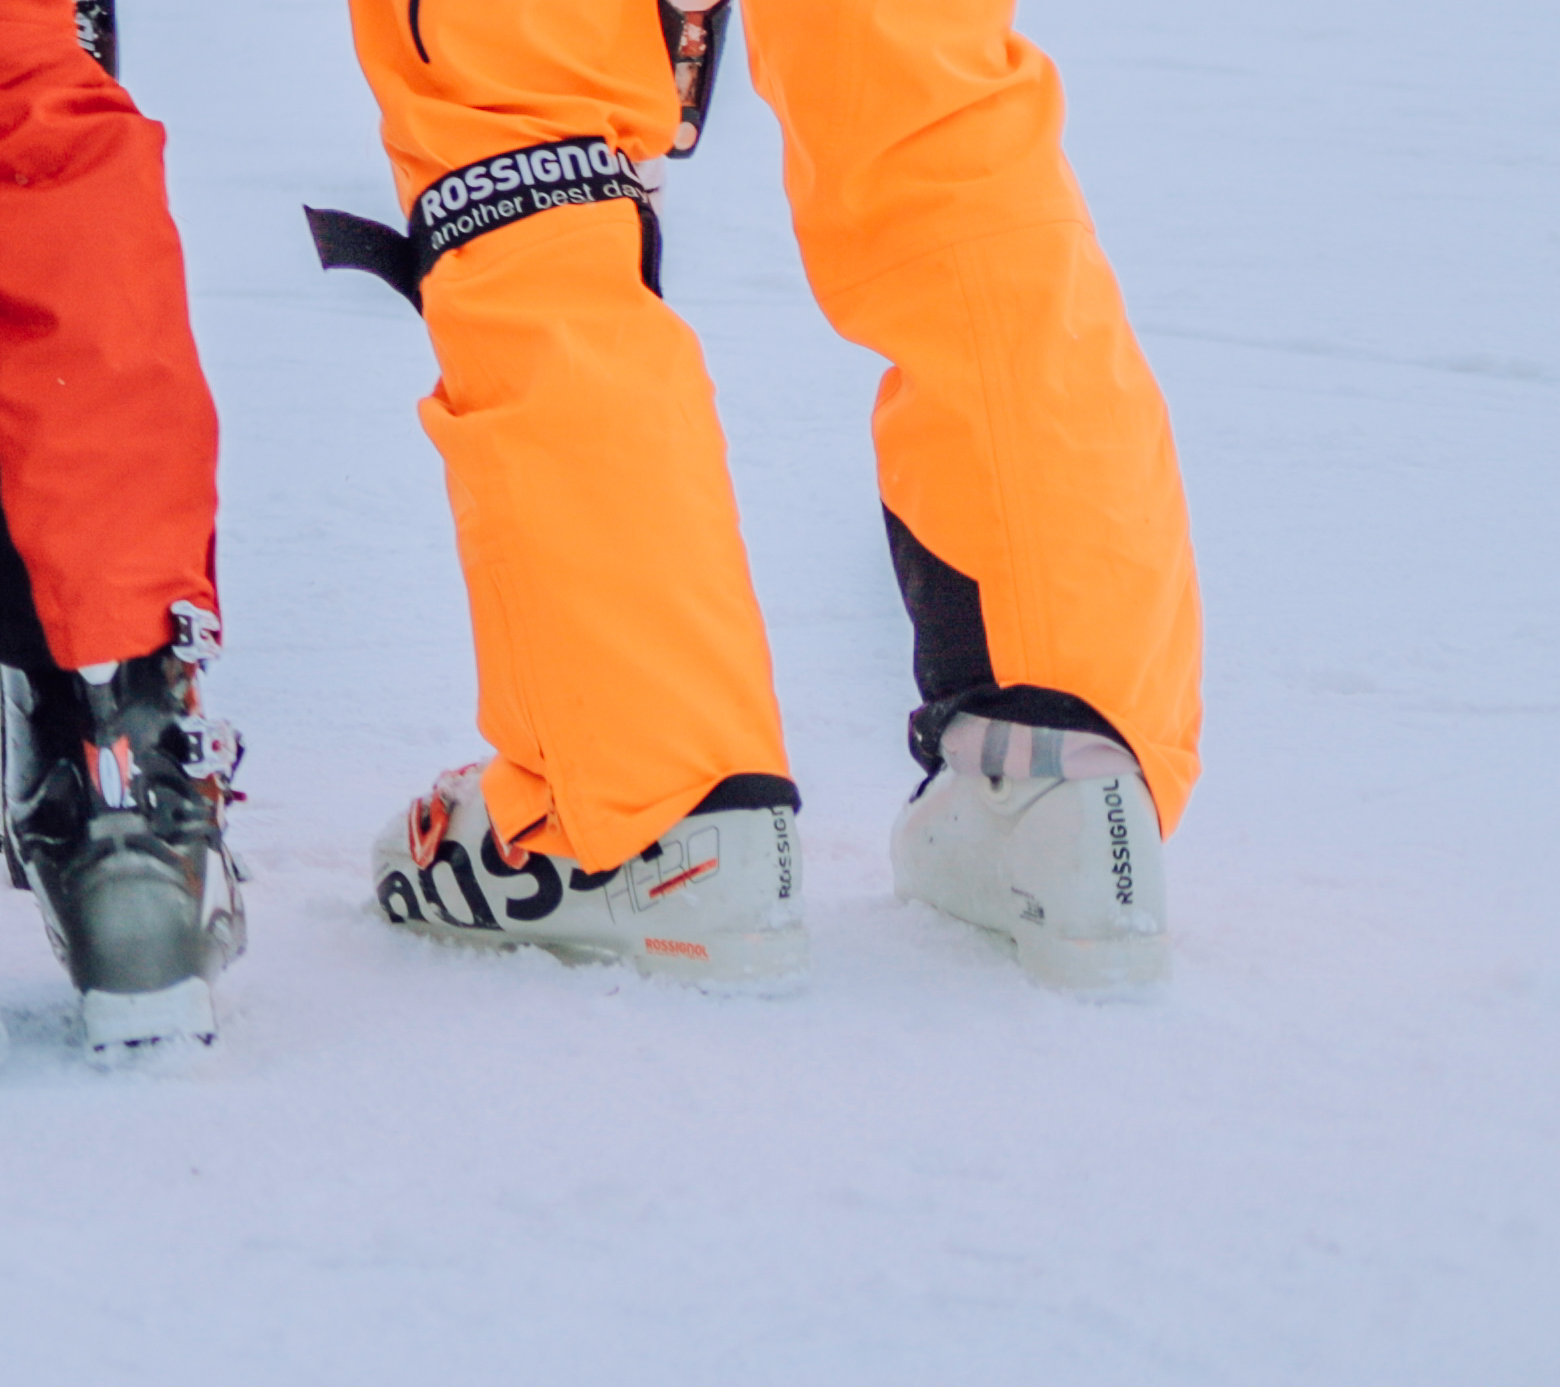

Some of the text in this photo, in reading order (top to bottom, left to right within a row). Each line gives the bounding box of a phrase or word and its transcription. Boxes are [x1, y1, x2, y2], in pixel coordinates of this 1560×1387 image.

[431, 195, 524, 250] another
[531, 182, 596, 210] best
[1102, 778, 1134, 905] ROSSIGNOL
[645, 937, 709, 959] ROSSIGNOL
